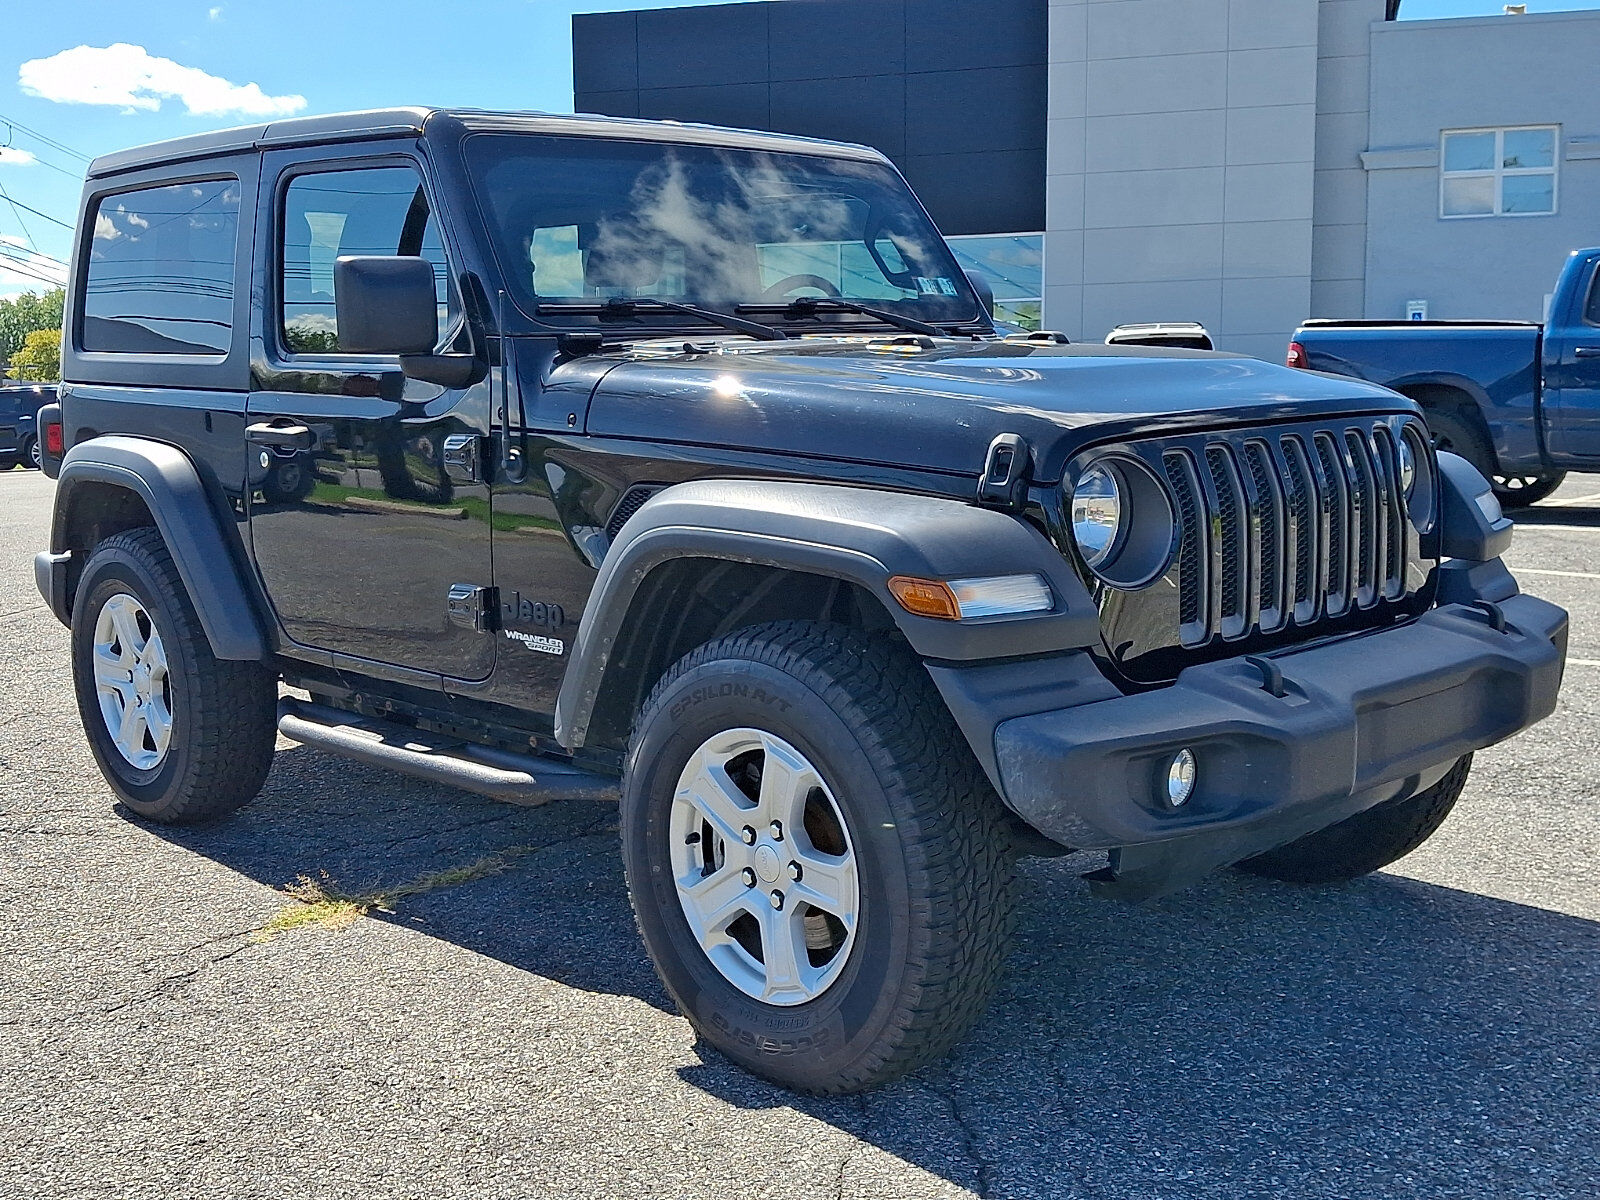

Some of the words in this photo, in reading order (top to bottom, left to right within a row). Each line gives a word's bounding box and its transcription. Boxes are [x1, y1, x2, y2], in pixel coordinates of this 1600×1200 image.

[502, 591, 564, 631] Jeep
[505, 629, 564, 648] WRANGLER
[527, 643, 563, 654] SPORT
[669, 683, 749, 721] EPSILON
